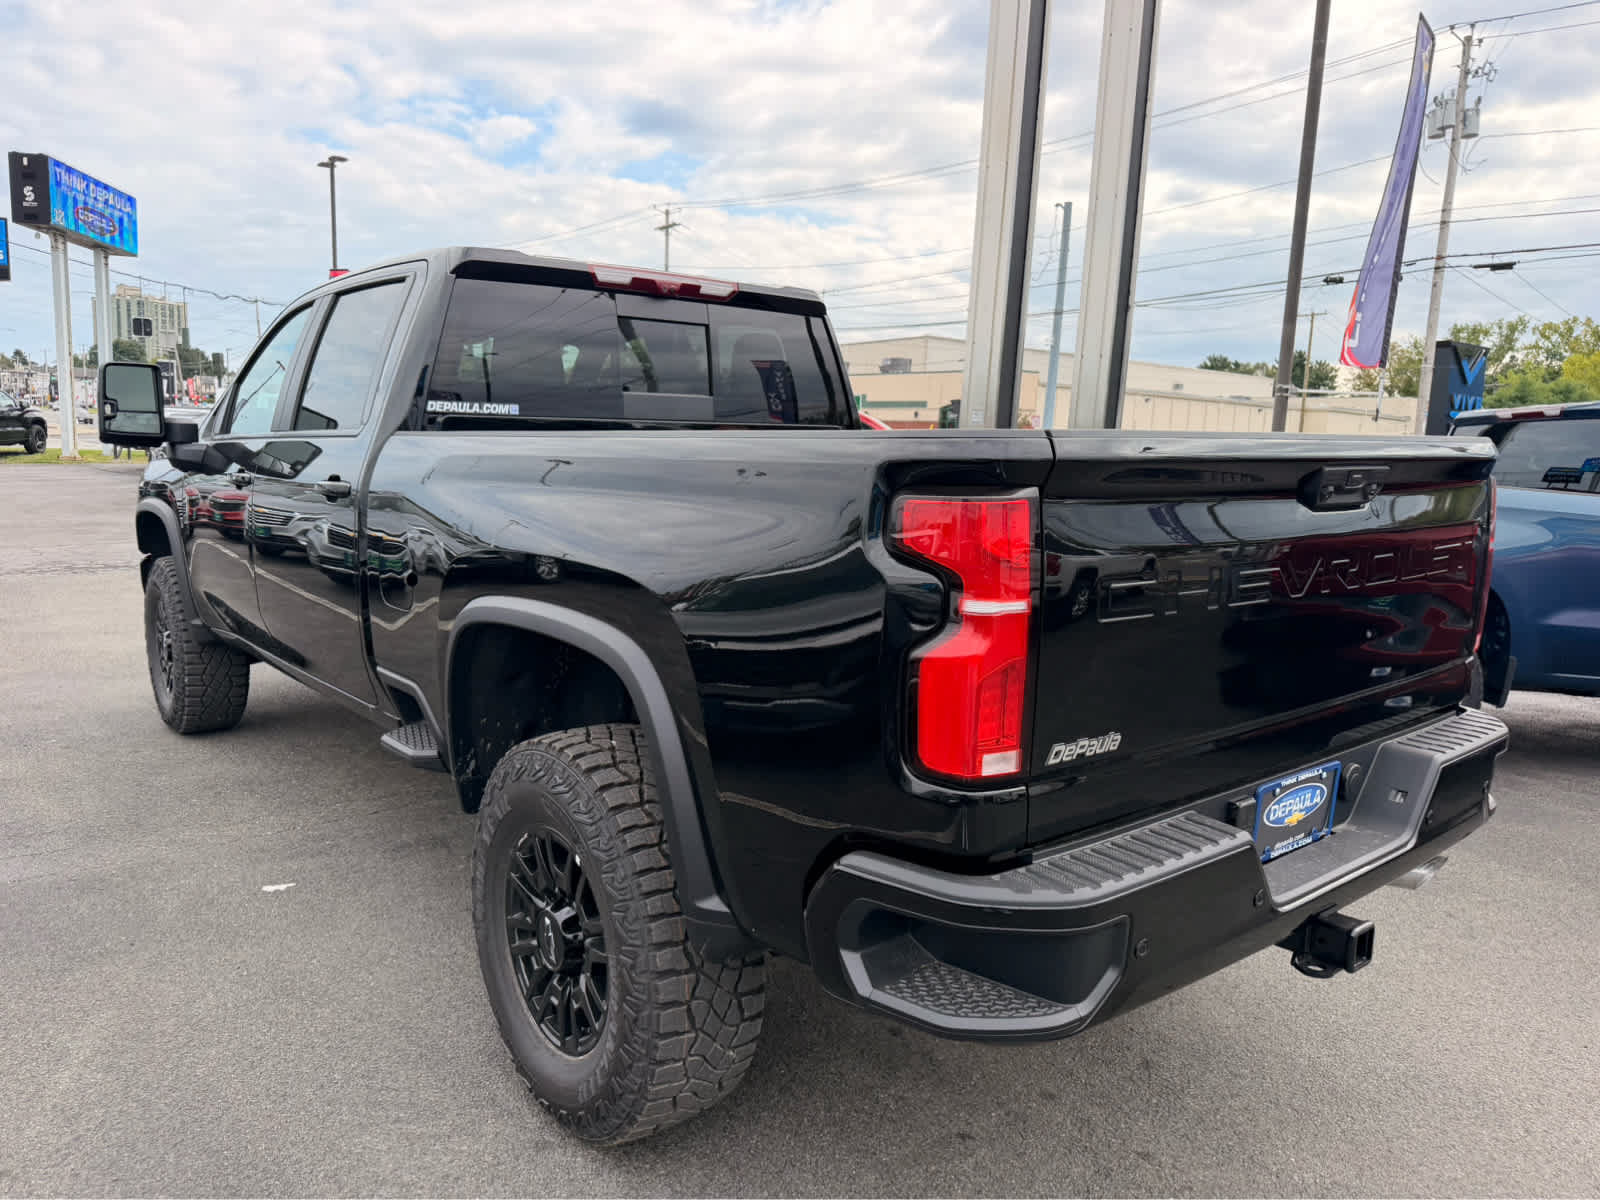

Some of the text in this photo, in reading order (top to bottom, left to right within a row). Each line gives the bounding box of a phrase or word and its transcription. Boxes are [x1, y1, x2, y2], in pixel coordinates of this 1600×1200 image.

[55, 166, 89, 195] THINK
[90, 183, 132, 213] DEPAULA
[426, 400, 510, 415] DEPAULA.COM
[1044, 731, 1122, 766] DePaula
[1269, 789, 1322, 822] DEPAULA
